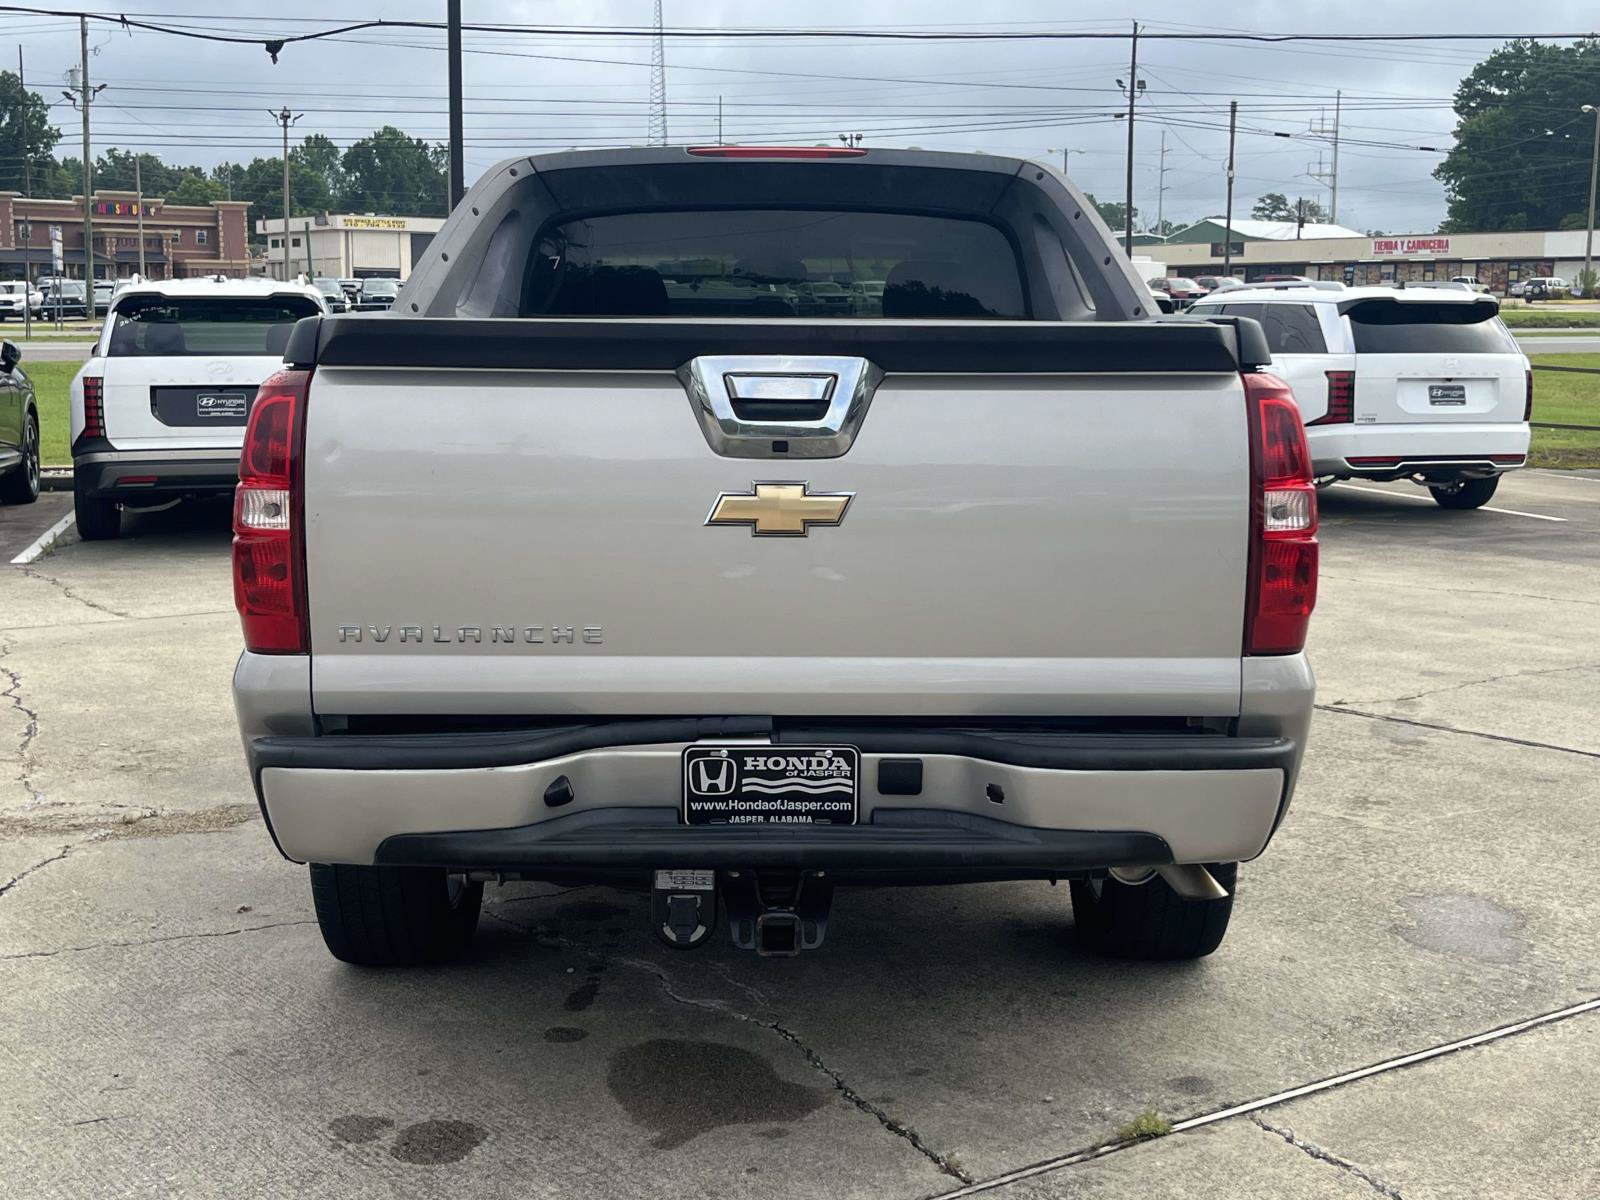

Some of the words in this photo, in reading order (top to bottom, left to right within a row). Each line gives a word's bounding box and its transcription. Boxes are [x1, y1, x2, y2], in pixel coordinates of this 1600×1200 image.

[1374, 240, 1398, 250] TIENDA
[1400, 240, 1405, 250] Y
[1407, 239, 1450, 250] CARNICERIA
[338, 625, 604, 644] AVALANCHE
[743, 756, 852, 770] HONDA
[691, 799, 852, 812] www.HondaofJasper.com
[769, 815, 813, 824] ALABAMA
